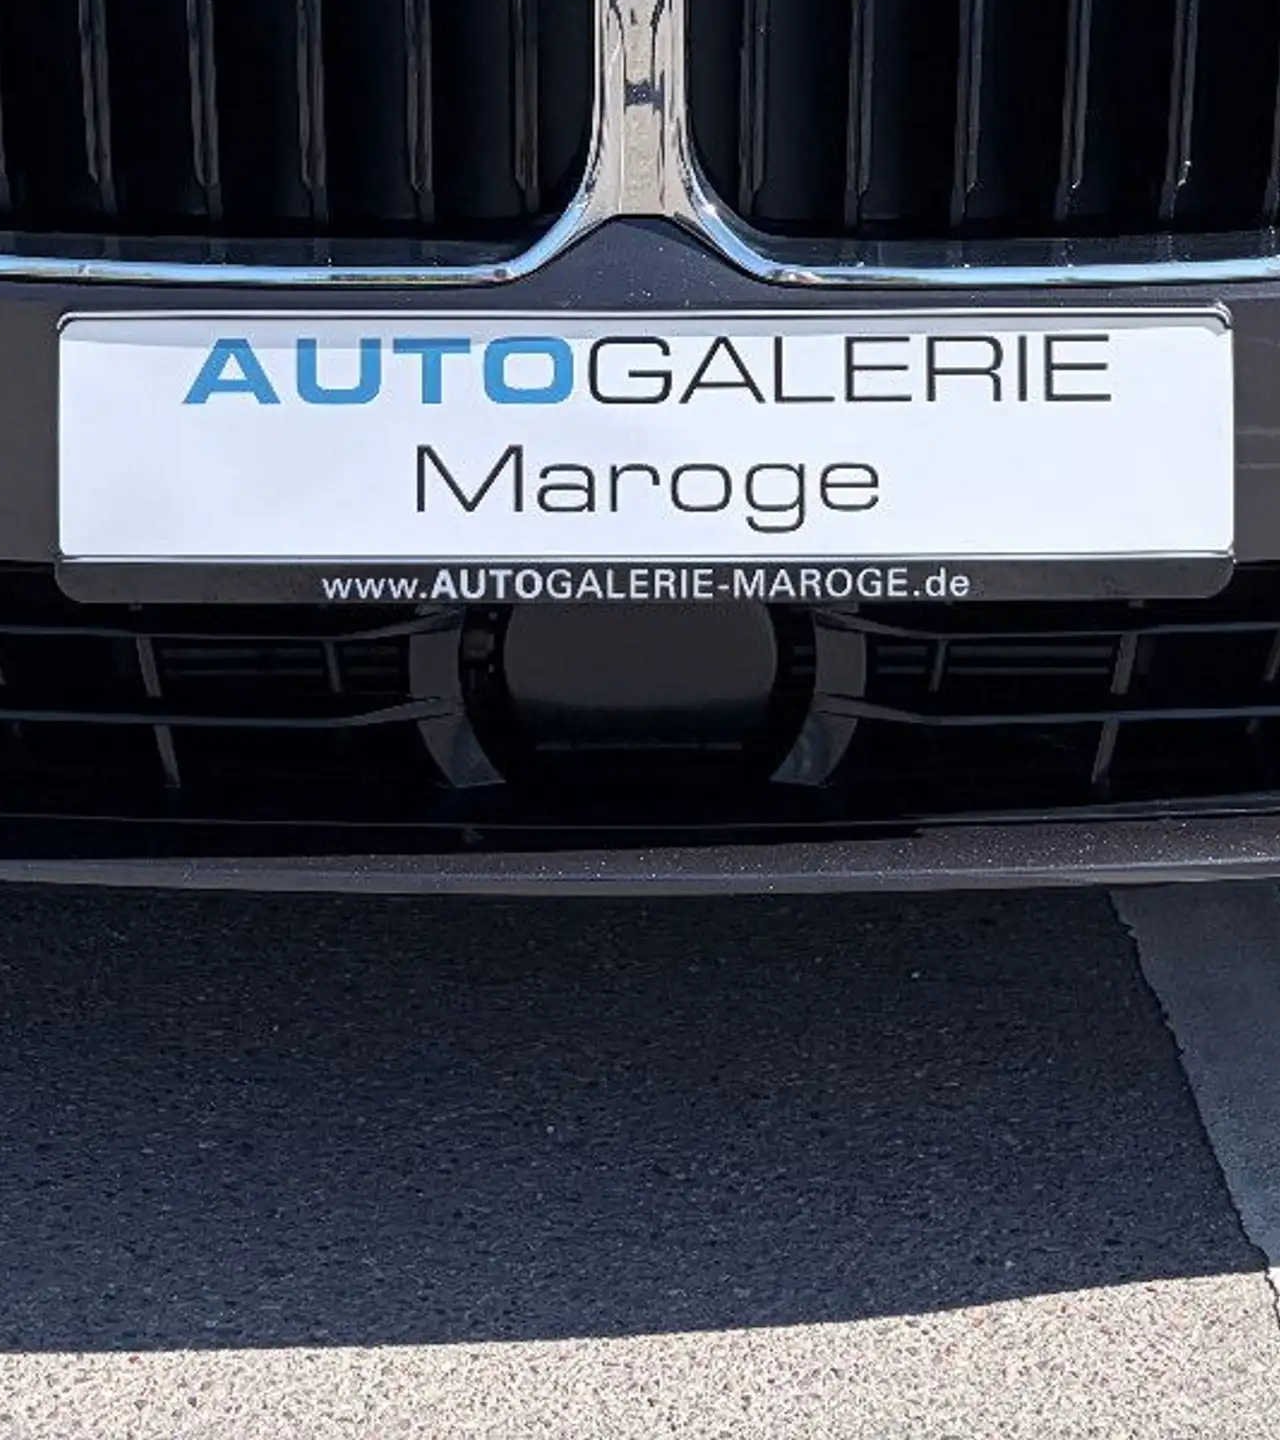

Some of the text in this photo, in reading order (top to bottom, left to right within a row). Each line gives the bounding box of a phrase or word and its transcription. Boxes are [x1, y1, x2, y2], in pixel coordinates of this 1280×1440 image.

[183, 334, 1112, 405] AUTOGALERIE
[416, 444, 879, 534] Maroge
[321, 566, 970, 601] www.AUTOGALERIE-MAROGE.de
